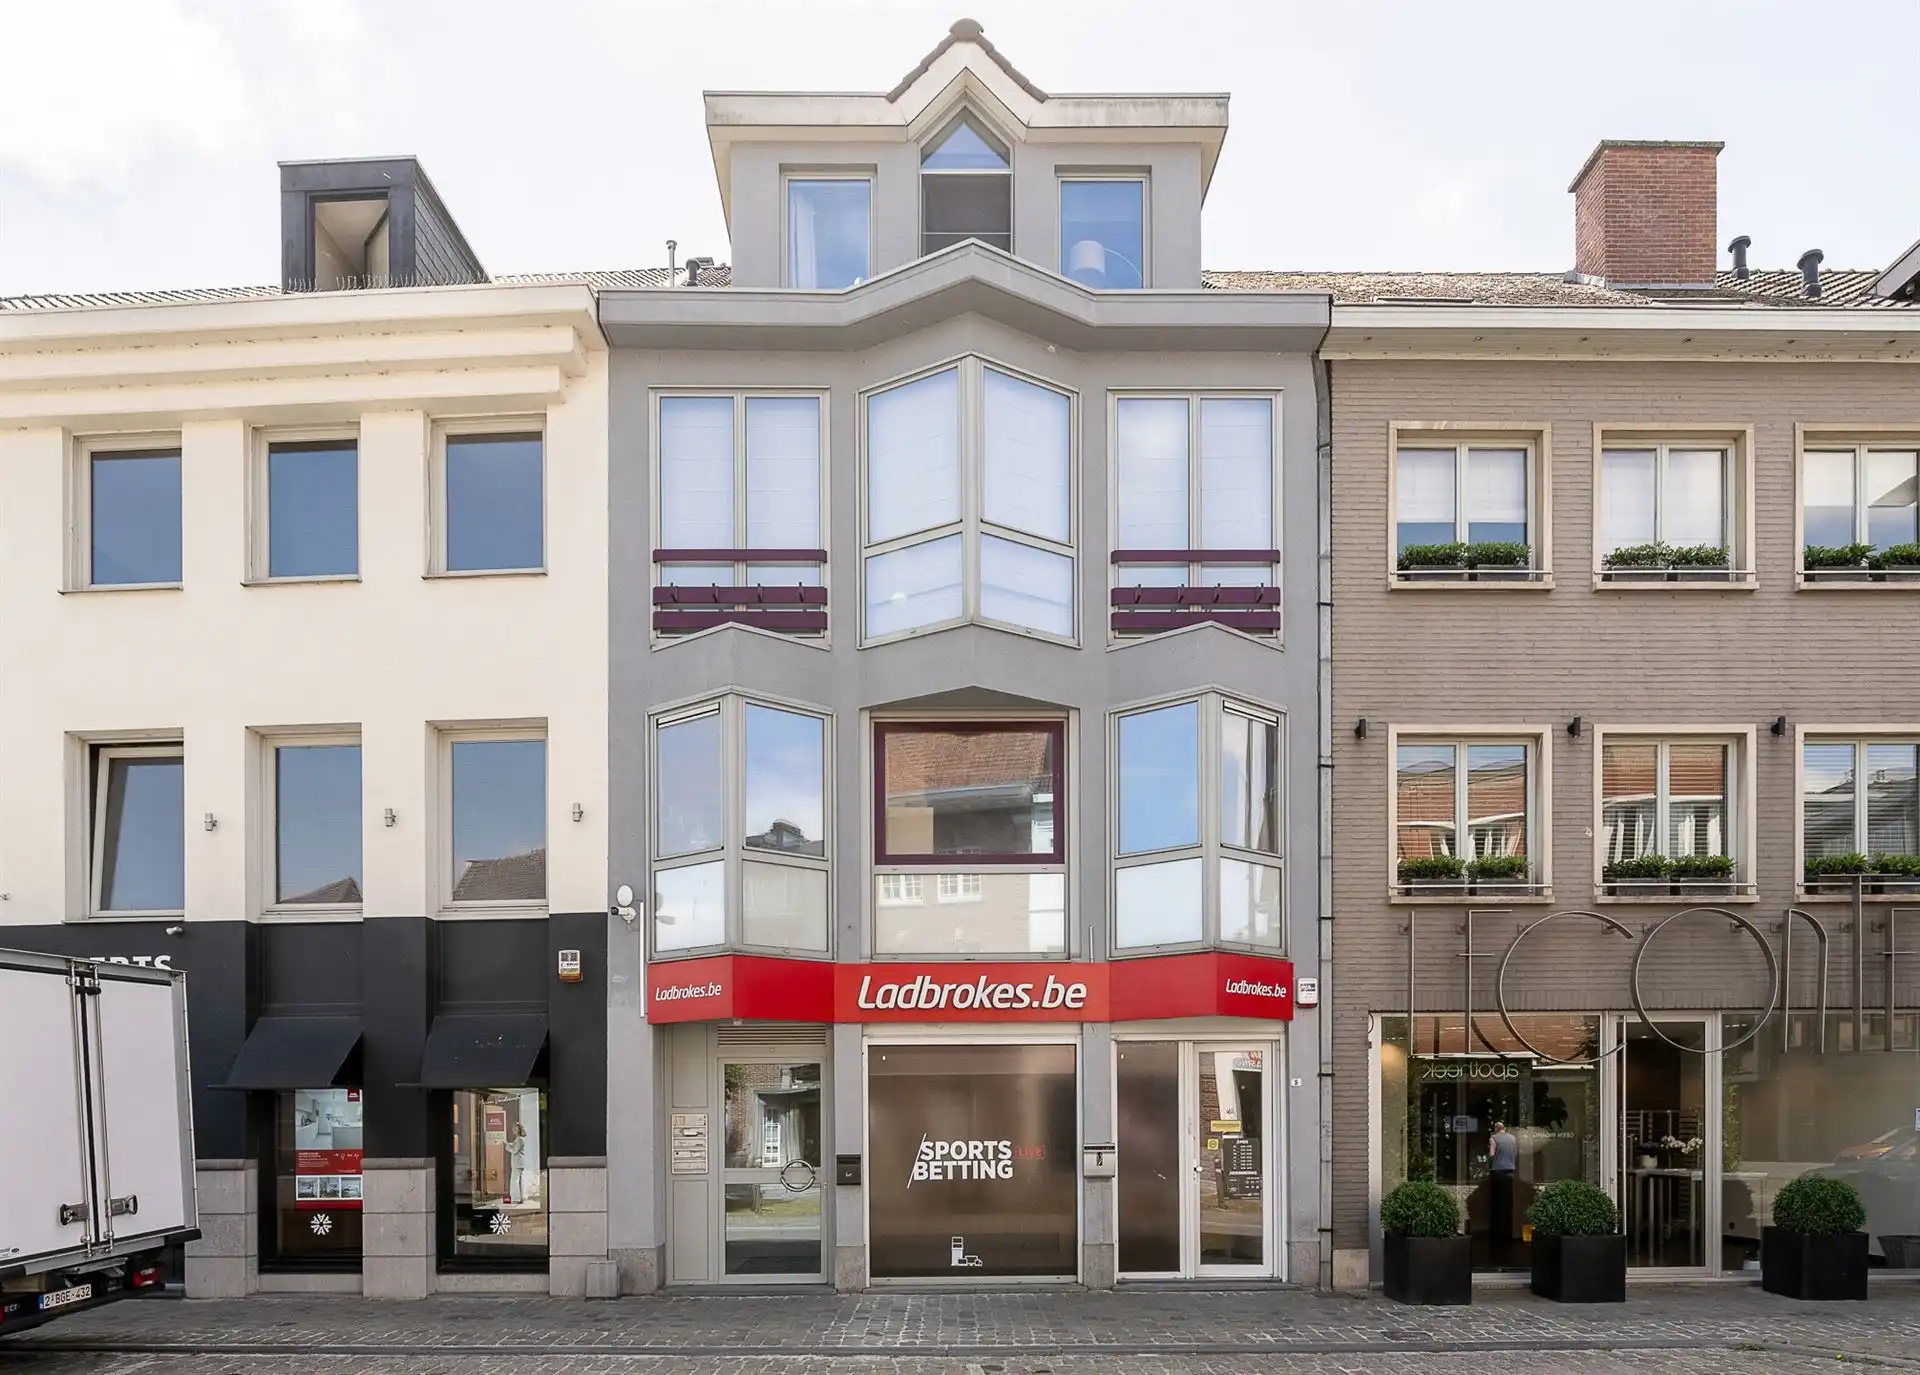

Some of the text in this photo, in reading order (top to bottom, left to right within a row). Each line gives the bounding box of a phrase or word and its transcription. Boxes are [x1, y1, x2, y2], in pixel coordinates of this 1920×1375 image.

[655, 982, 722, 1001] Ladbrokes.be
[857, 975, 1088, 1009] Ladbrokes.be
[1225, 978, 1287, 998] Ladbrokes.be
[919, 1140, 1012, 1161] SPORTS
[913, 1160, 1014, 1181] BETTING
